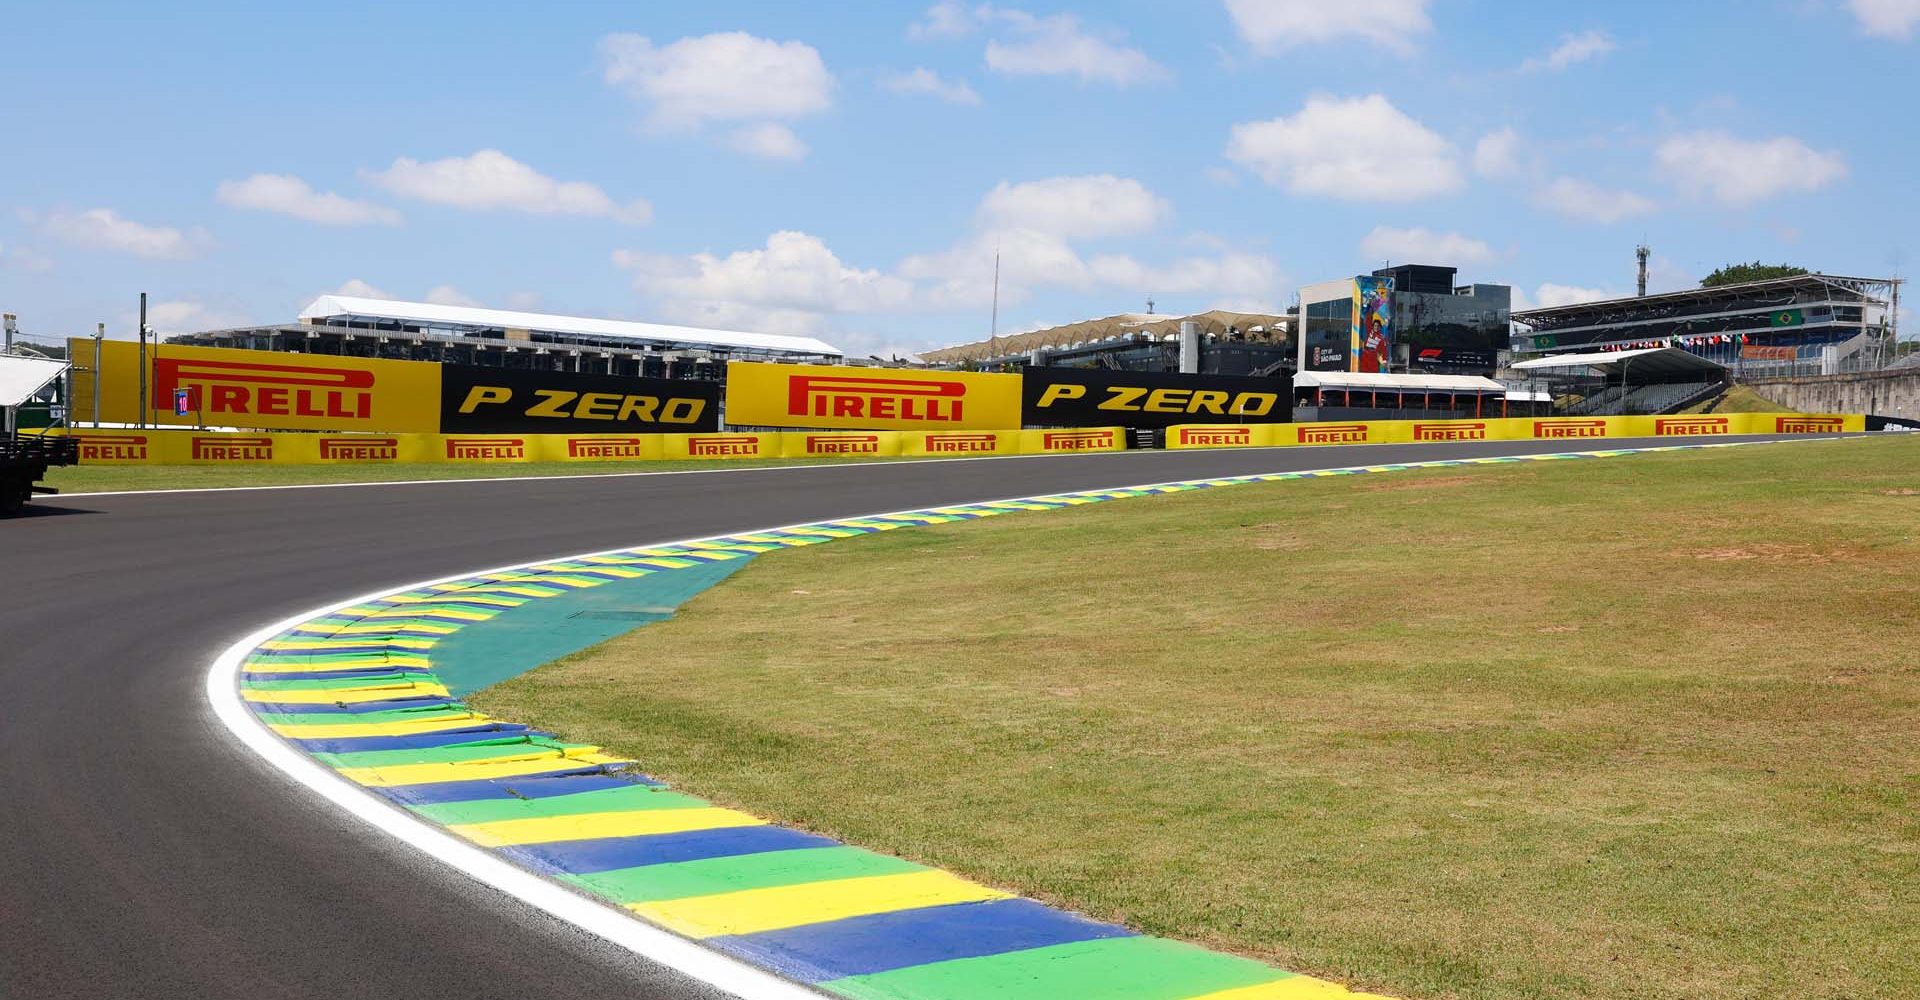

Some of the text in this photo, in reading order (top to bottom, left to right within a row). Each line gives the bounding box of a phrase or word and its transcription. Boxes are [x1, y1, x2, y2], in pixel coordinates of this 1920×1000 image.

[152, 358, 375, 419] PIRELLI
[458, 386, 706, 424] P ZERO
[788, 375, 967, 423] PIRELLI
[1036, 383, 1278, 416] P ZERO
[1413, 422, 1486, 441] PIRELLI
[1533, 420, 1606, 438] PIRELLI
[1655, 417, 1729, 436] PIRELLI
[1775, 416, 1844, 433] PIRELLI
[806, 435, 879, 453] PIRELLI
[925, 434, 997, 452] PIRELLI
[1043, 431, 1114, 450] PIRELLI
[1179, 428, 1250, 445] PIRELLI
[1297, 425, 1368, 444] PIRELLI
[192, 437, 273, 460] PIRELLI
[319, 438, 397, 460] PIRELLI
[446, 438, 524, 459] PIRELLI
[567, 438, 641, 458] PIRELLI
[687, 437, 759, 456] PIRELLI
